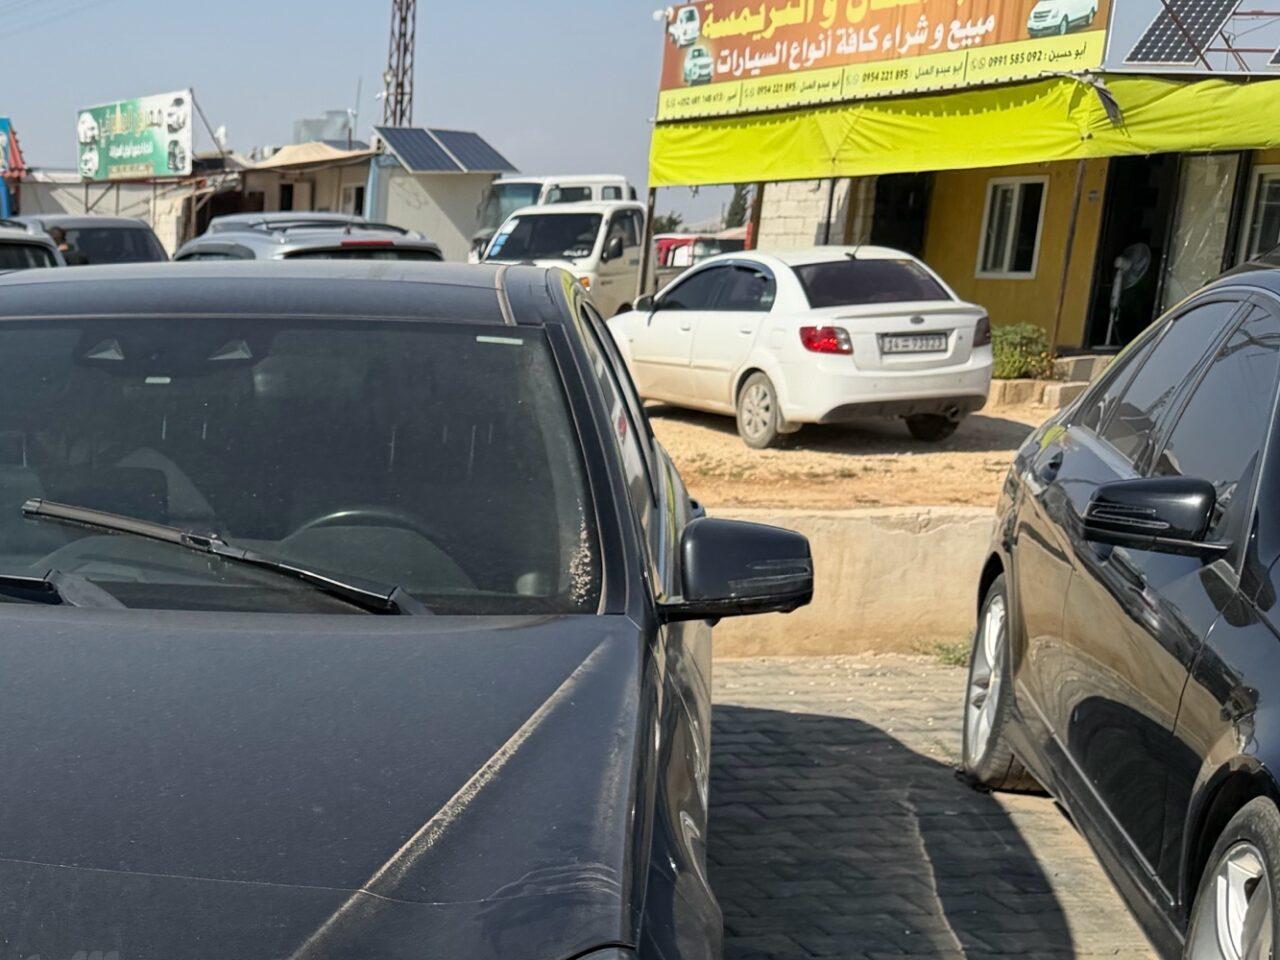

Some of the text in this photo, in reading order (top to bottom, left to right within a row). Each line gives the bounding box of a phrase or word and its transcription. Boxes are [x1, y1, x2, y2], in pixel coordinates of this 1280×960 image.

[717, 14, 996, 76] مبيع و شراء كافة أنواع السيارات
[988, 55, 1008, 68] 0991
[1010, 53, 1025, 65] 585
[1026, 50, 1042, 63] 092
